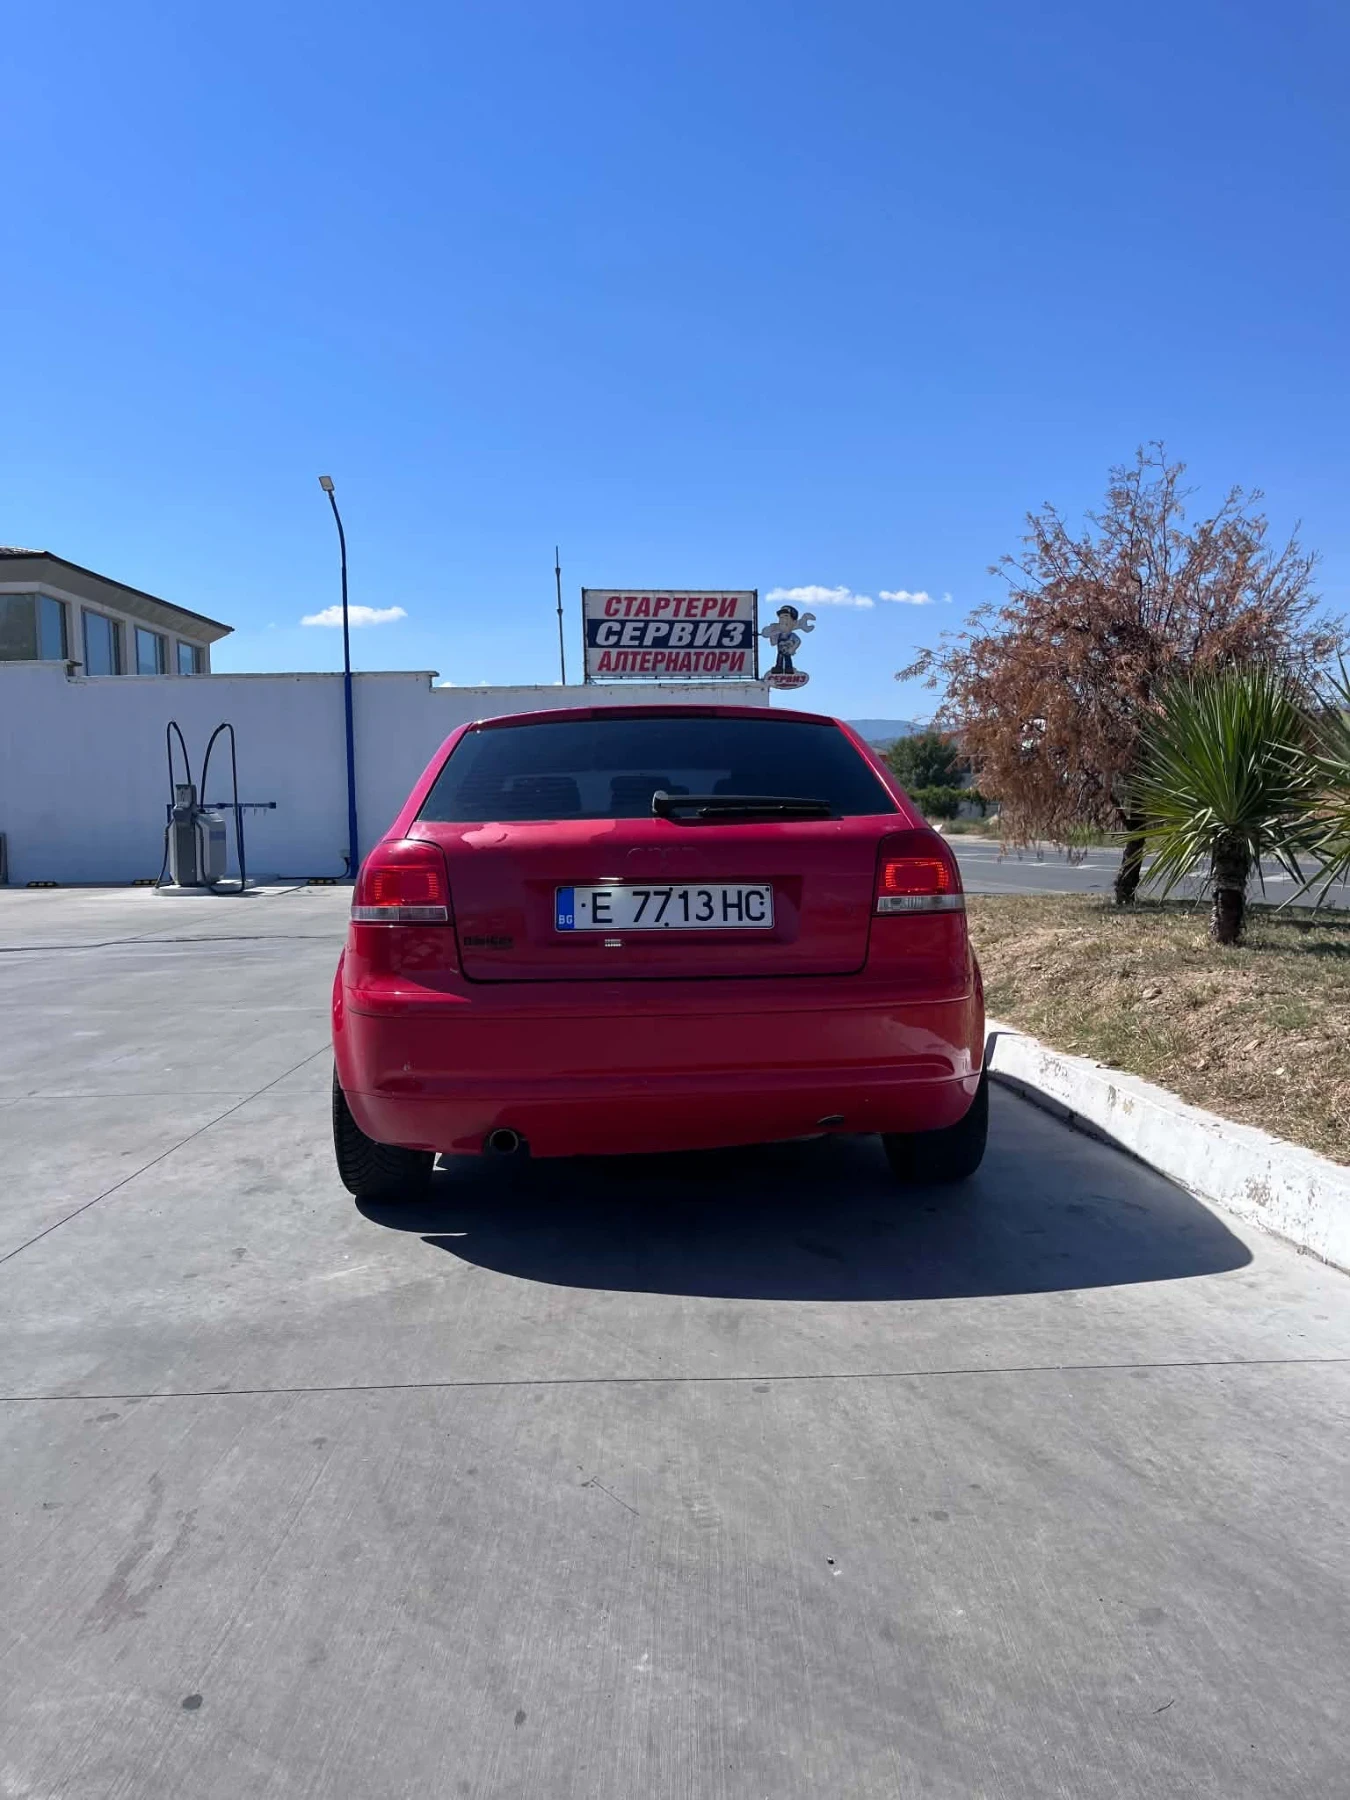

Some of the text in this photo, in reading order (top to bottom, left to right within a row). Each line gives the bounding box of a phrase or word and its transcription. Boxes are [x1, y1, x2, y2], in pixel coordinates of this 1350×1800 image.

[604, 596, 738, 618] СТАРТЕРИ
[595, 621, 745, 646] СЕРВИЗ
[597, 651, 745, 672] АЛТЕРНАТОРИ
[591, 890, 765, 923] E 7713 HC
[558, 914, 573, 924] BG
